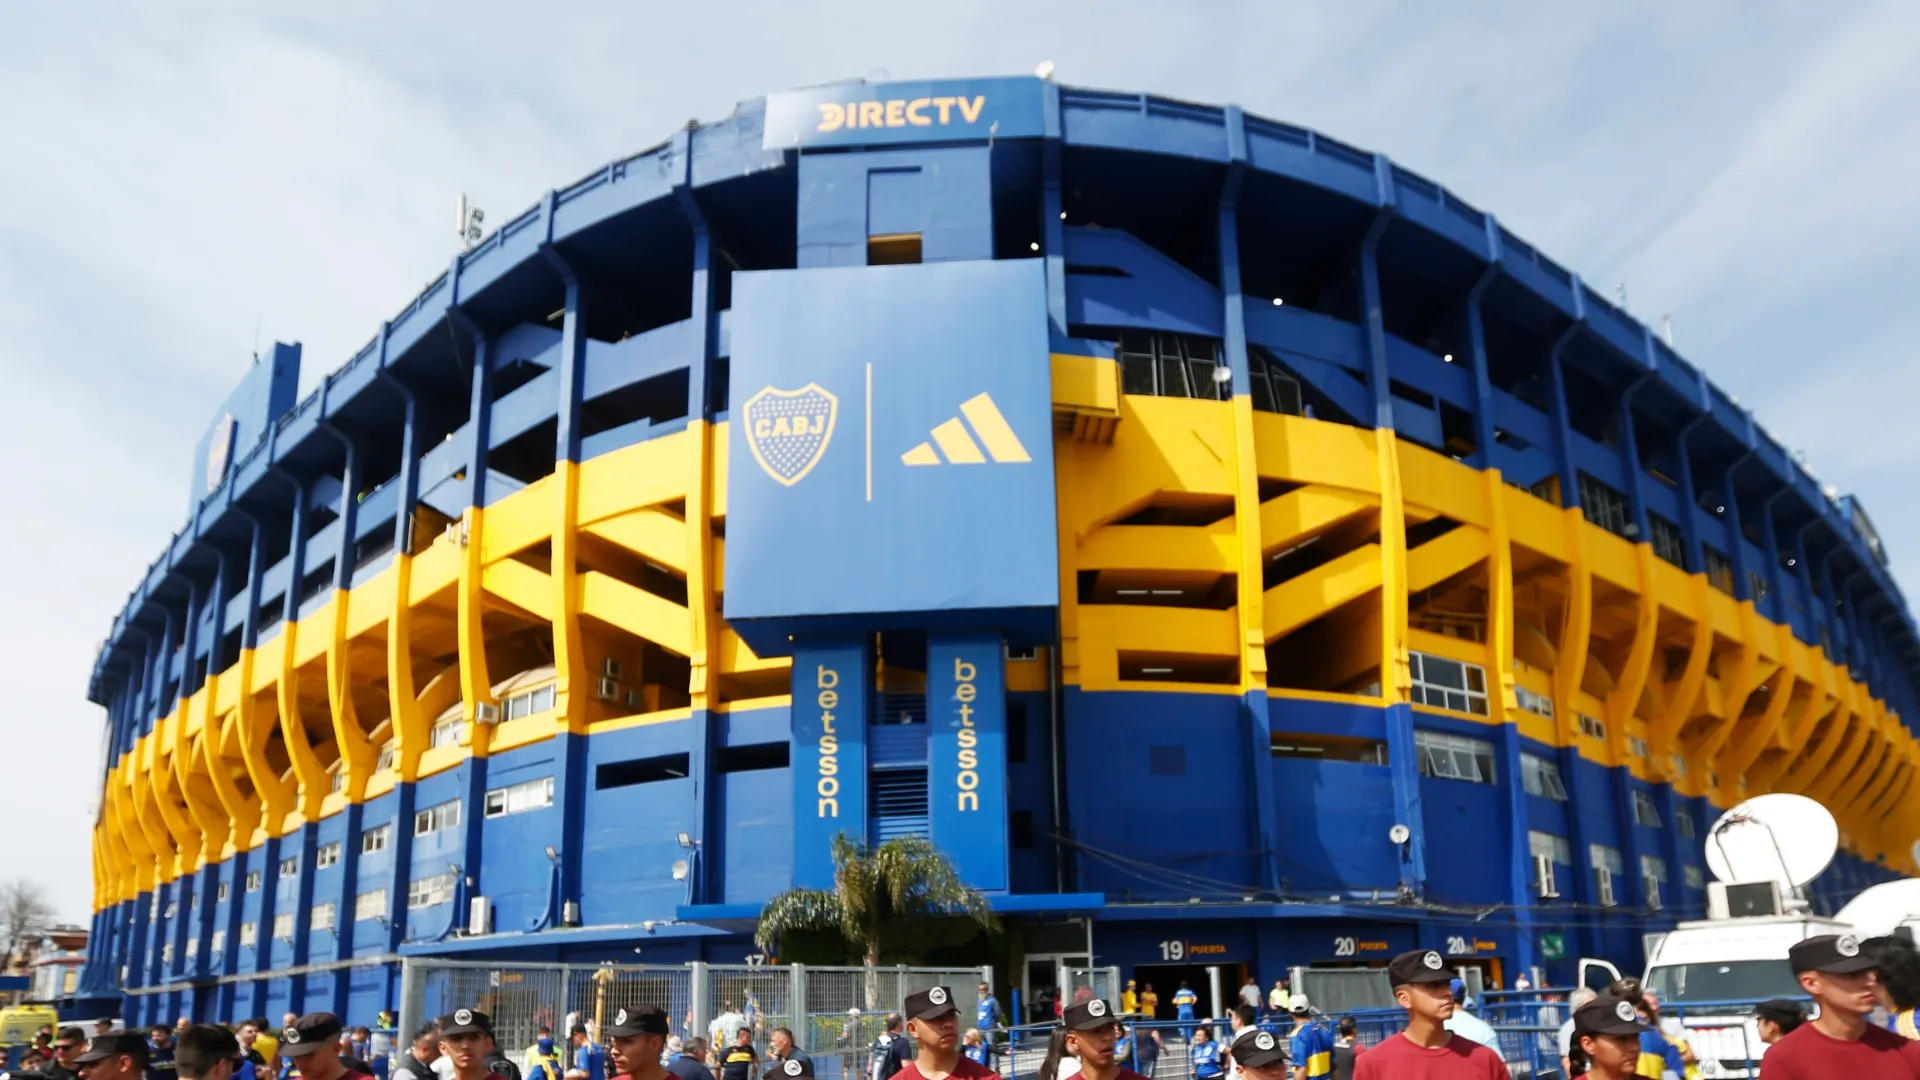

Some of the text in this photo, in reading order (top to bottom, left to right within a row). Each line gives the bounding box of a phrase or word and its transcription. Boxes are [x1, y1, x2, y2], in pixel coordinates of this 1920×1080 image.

[817, 96, 985, 132] DIRECTV
[755, 414, 825, 438] CABJ
[817, 665, 839, 818] betsson
[954, 658, 979, 812] betsson
[1159, 940, 1226, 960] 19 PUERTA
[1334, 937, 1355, 955] 20
[745, 954, 764, 971] 17
